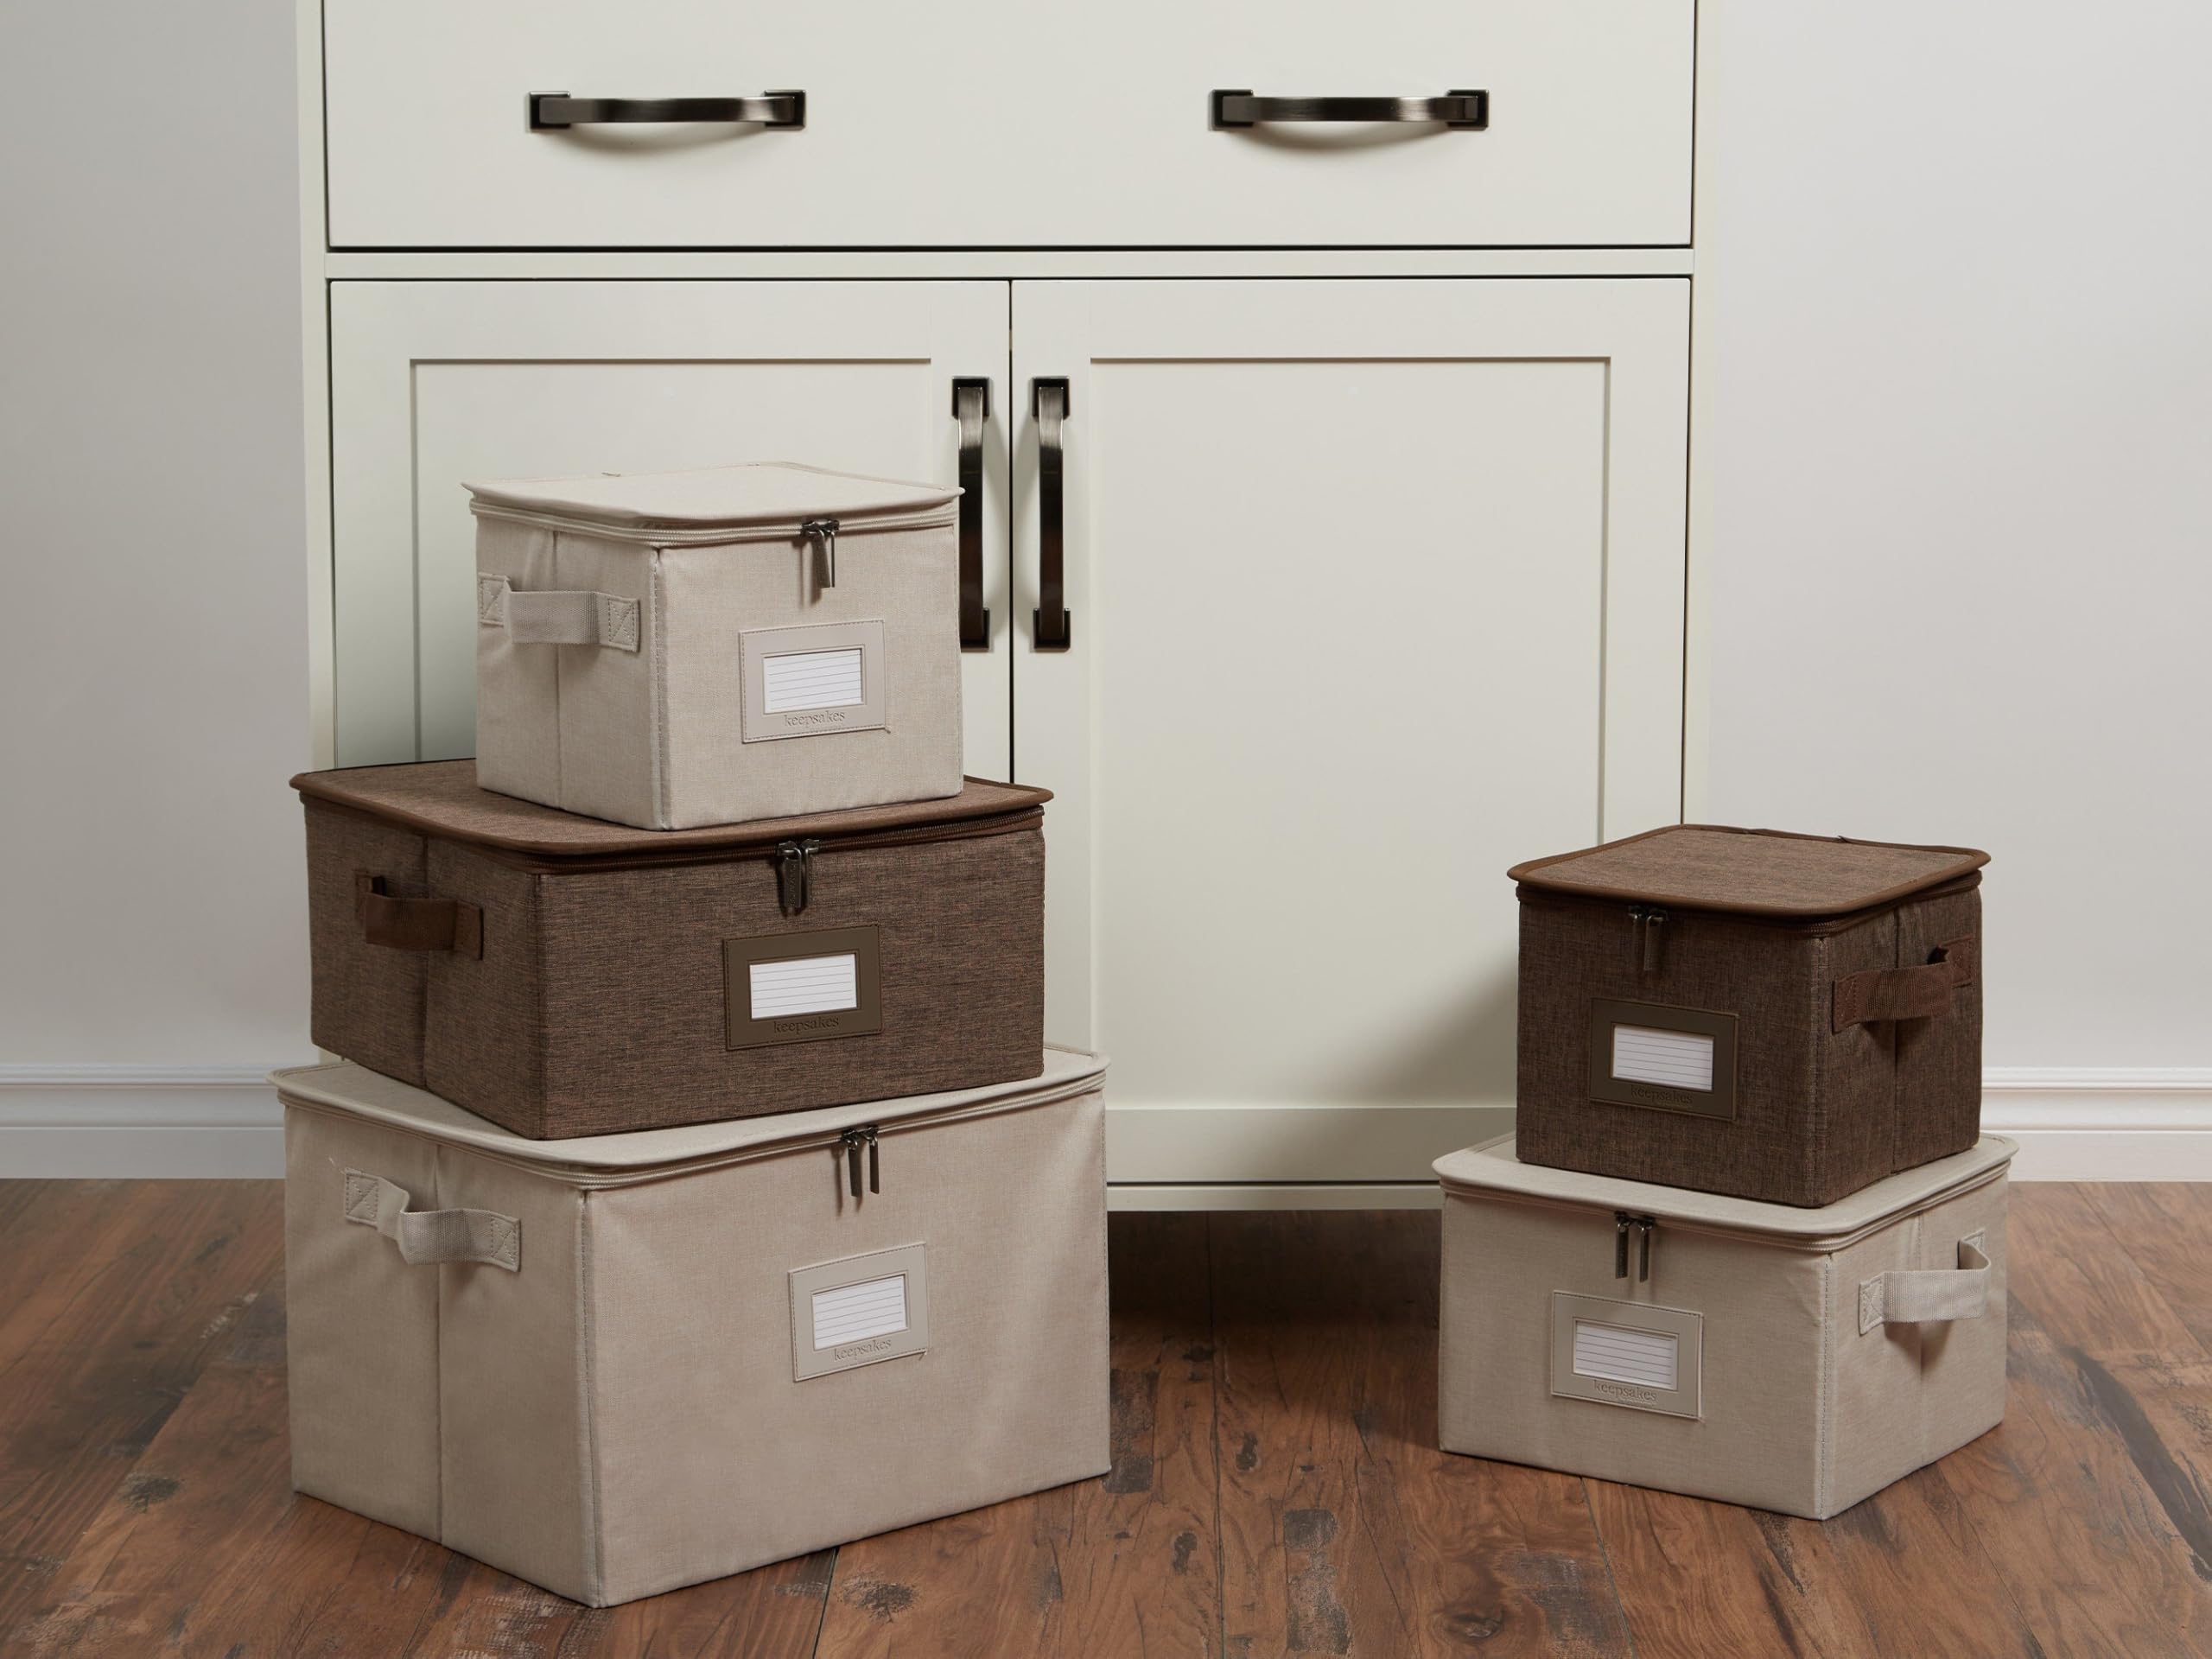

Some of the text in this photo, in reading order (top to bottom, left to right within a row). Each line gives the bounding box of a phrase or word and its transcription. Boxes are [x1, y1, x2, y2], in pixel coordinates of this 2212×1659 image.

[784, 710, 845, 727] keepsakes
[773, 1017, 838, 1035] keepsakes
[1631, 1085, 1694, 1104] keepsakes
[834, 1340, 891, 1361] keepsakes
[1593, 1380, 1656, 1401] keepsakes
